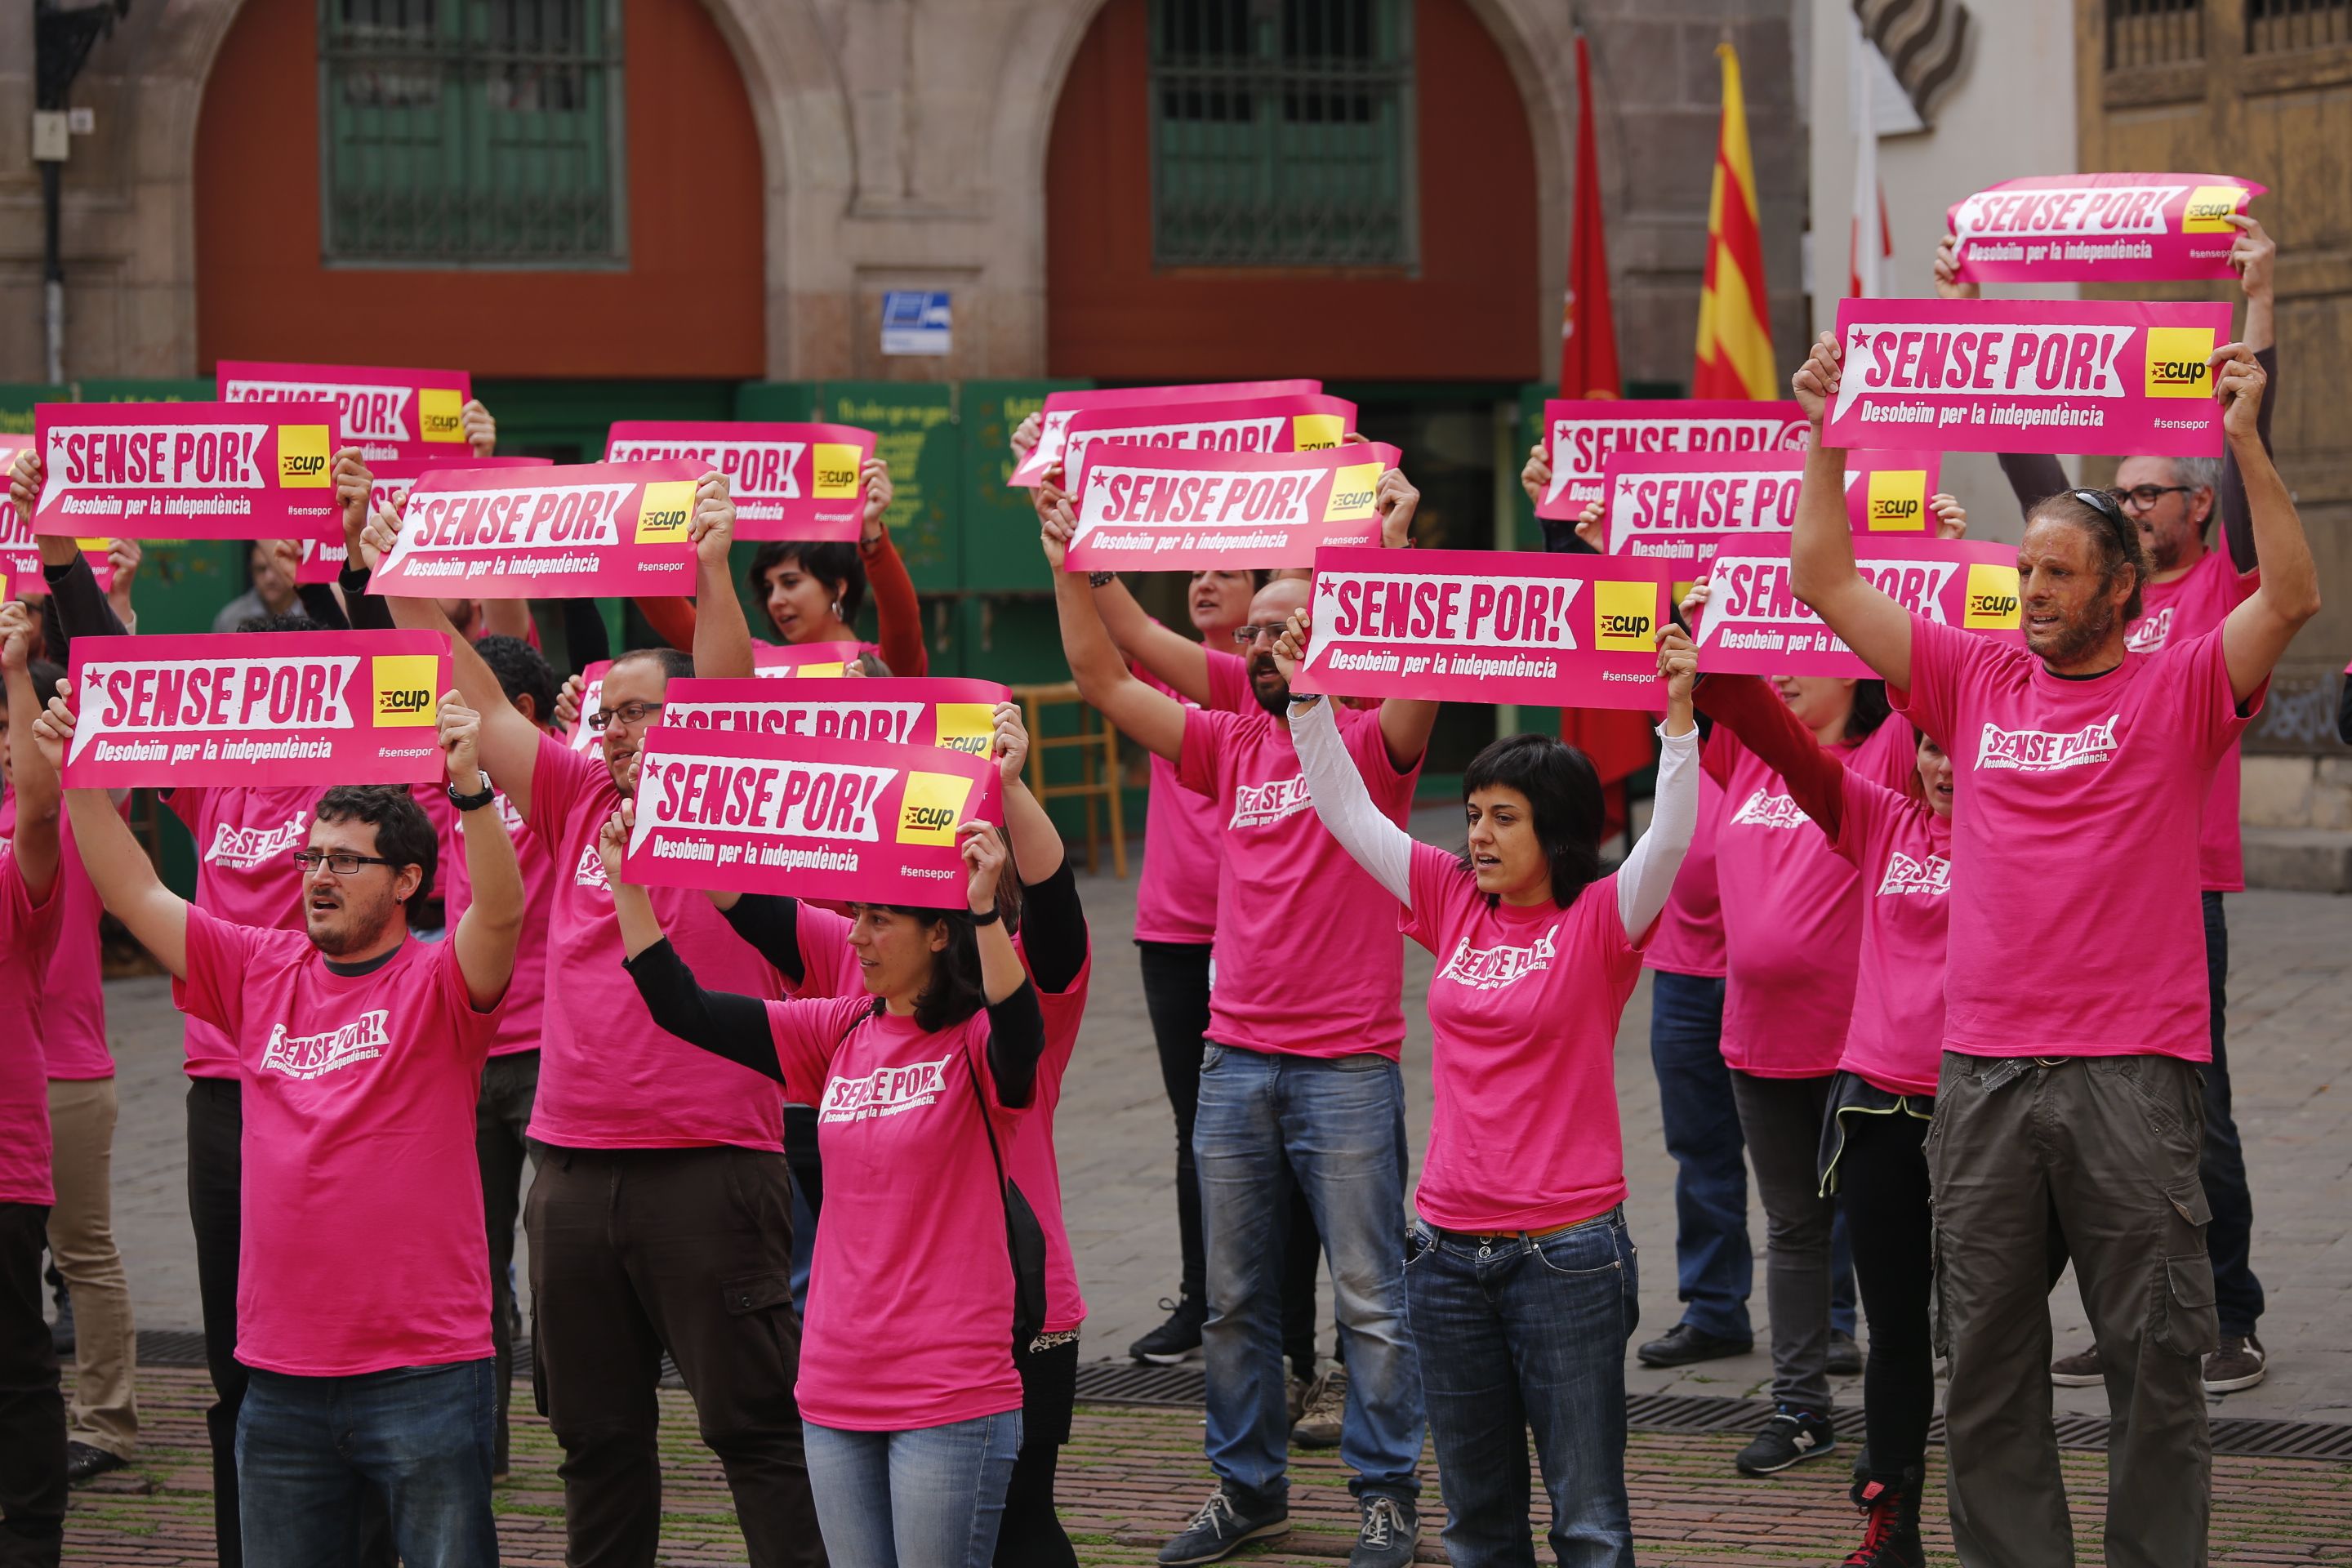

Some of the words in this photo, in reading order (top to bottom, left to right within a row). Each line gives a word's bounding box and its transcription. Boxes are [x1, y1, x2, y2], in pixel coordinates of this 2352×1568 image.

[1971, 192, 2080, 231] SENSE
[2077, 190, 2167, 229] POR!
[1967, 242, 2024, 261] Desobeïm
[2026, 244, 2048, 265] per
[2051, 242, 2062, 260] la
[2065, 239, 2153, 264] independència
[2189, 248, 2232, 259] #sensepo
[1864, 331, 2003, 390] SENSE
[2005, 332, 2114, 390] POR!
[1860, 400, 1934, 424] Desobeïm
[1938, 405, 1967, 429] per
[1971, 403, 1984, 425] la
[1990, 401, 2105, 430] independència
[2154, 418, 2210, 431] #sensepor
[66, 433, 167, 483] SENSE
[173, 431, 252, 483] POR!
[61, 495, 122, 514] Desobeïm
[124, 498, 148, 519] per
[150, 497, 161, 514] la
[164, 493, 251, 519] independència
[287, 506, 332, 516] #sensepor
[1102, 473, 1217, 523] SENSE
[1217, 474, 1312, 520] POR!
[1633, 479, 1748, 529] SENSE
[1752, 479, 1802, 527] PO
[413, 492, 528, 546] SENSE
[524, 491, 619, 542] POR!
[1091, 531, 1155, 550] Desobeïm
[1154, 534, 1181, 554] per
[1182, 532, 1195, 549] la
[1196, 530, 1288, 553] independència
[1322, 535, 1369, 546] #sensepor
[1632, 539, 1694, 559] Desobeïm
[403, 554, 465, 577] Desobeïm
[466, 559, 492, 581] per
[492, 556, 505, 575] la
[508, 551, 599, 579] independència
[637, 561, 685, 573] #sensepor
[1334, 580, 1461, 639] SENSE
[1466, 584, 1565, 641] POR!
[1719, 628, 1784, 651] Desobeïm
[1786, 633, 1811, 655] per
[1814, 631, 1828, 652] la
[1329, 648, 1400, 672] Desobeïm
[1401, 654, 1430, 677] per
[1433, 653, 1446, 675] la
[1450, 653, 1557, 679] independència
[1602, 670, 1657, 684] #sensepor
[102, 667, 235, 728] SENSE
[239, 664, 342, 724] POR!
[95, 739, 167, 762] Desobeïm
[170, 743, 200, 766] per
[203, 737, 217, 760] la
[220, 735, 332, 764] independència
[378, 746, 433, 758] #sensepor
[1987, 731, 2057, 762] SENSE
[657, 762, 779, 826] SENSE
[776, 770, 878, 833] POR!
[653, 834, 715, 861] Desobeïm
[717, 843, 744, 867] per
[744, 840, 757, 865] la
[760, 842, 859, 872] independència
[901, 865, 956, 880] #sensepor
[272, 1033, 336, 1067] SENSE
[830, 1071, 889, 1107] SENSE
[856, 1110, 868, 1123] per
[868, 1105, 877, 1118] la
